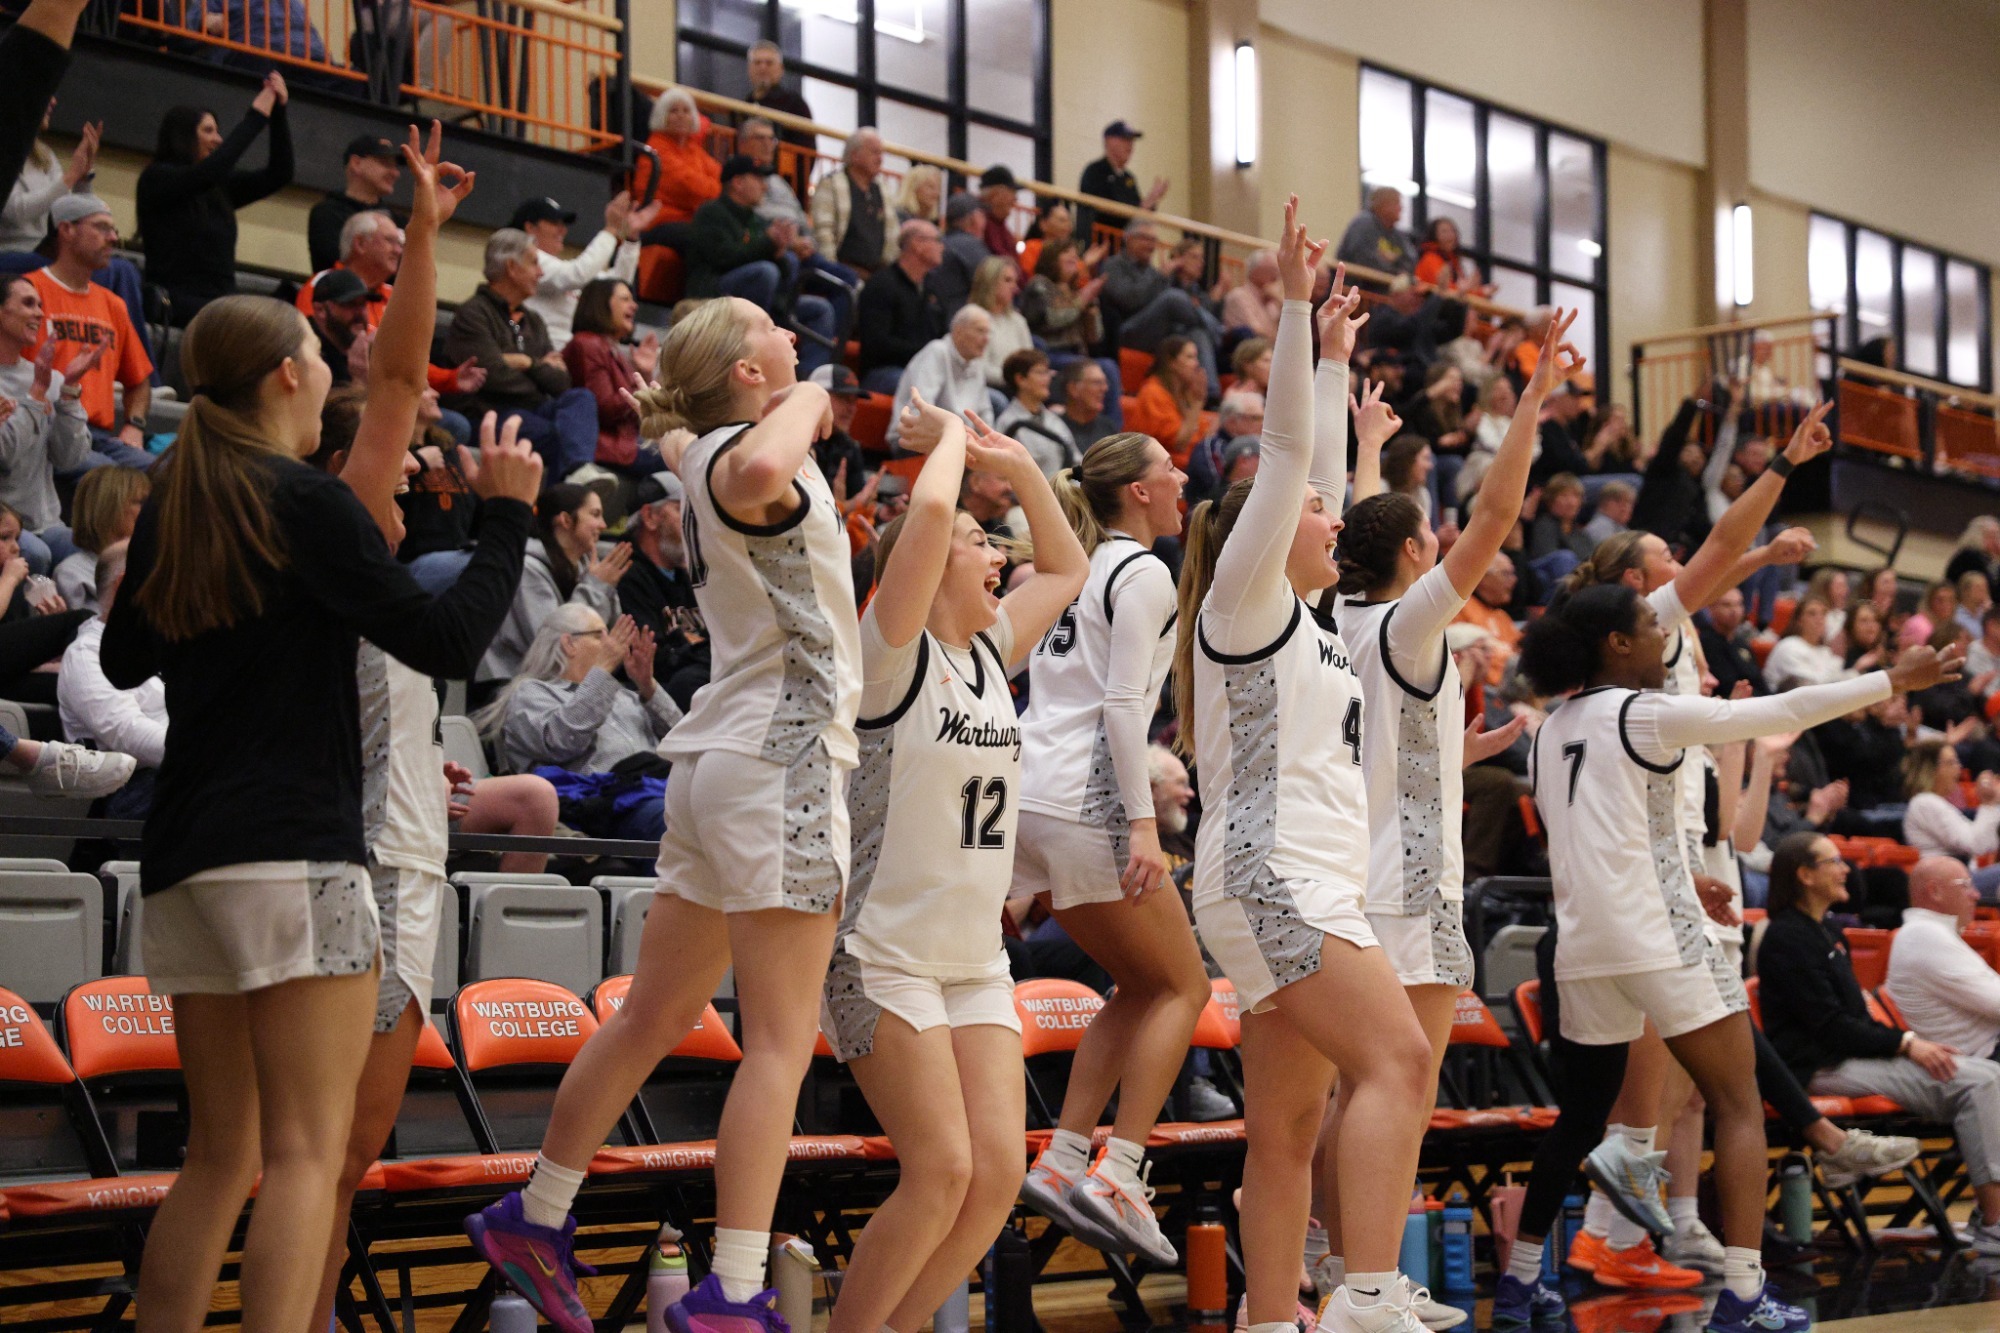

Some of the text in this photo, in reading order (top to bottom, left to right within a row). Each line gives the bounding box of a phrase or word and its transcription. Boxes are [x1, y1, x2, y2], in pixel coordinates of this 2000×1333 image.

[935, 706, 1022, 762] Wartburg
[1561, 738, 1587, 808] 7
[960, 775, 1008, 849] 12
[81, 994, 173, 1012] WARTBU
[471, 1001, 585, 1018] WARTBURG
[1020, 997, 1106, 1012] WARTBURG
[102, 1015, 174, 1034] COLLE
[489, 1020, 580, 1037] COLLEGE
[1035, 1013, 1097, 1029] COLLEG
[786, 1142, 847, 1157] NIGHTS
[481, 1157, 538, 1175] KNIGH
[87, 1185, 170, 1209] KNIGHT
